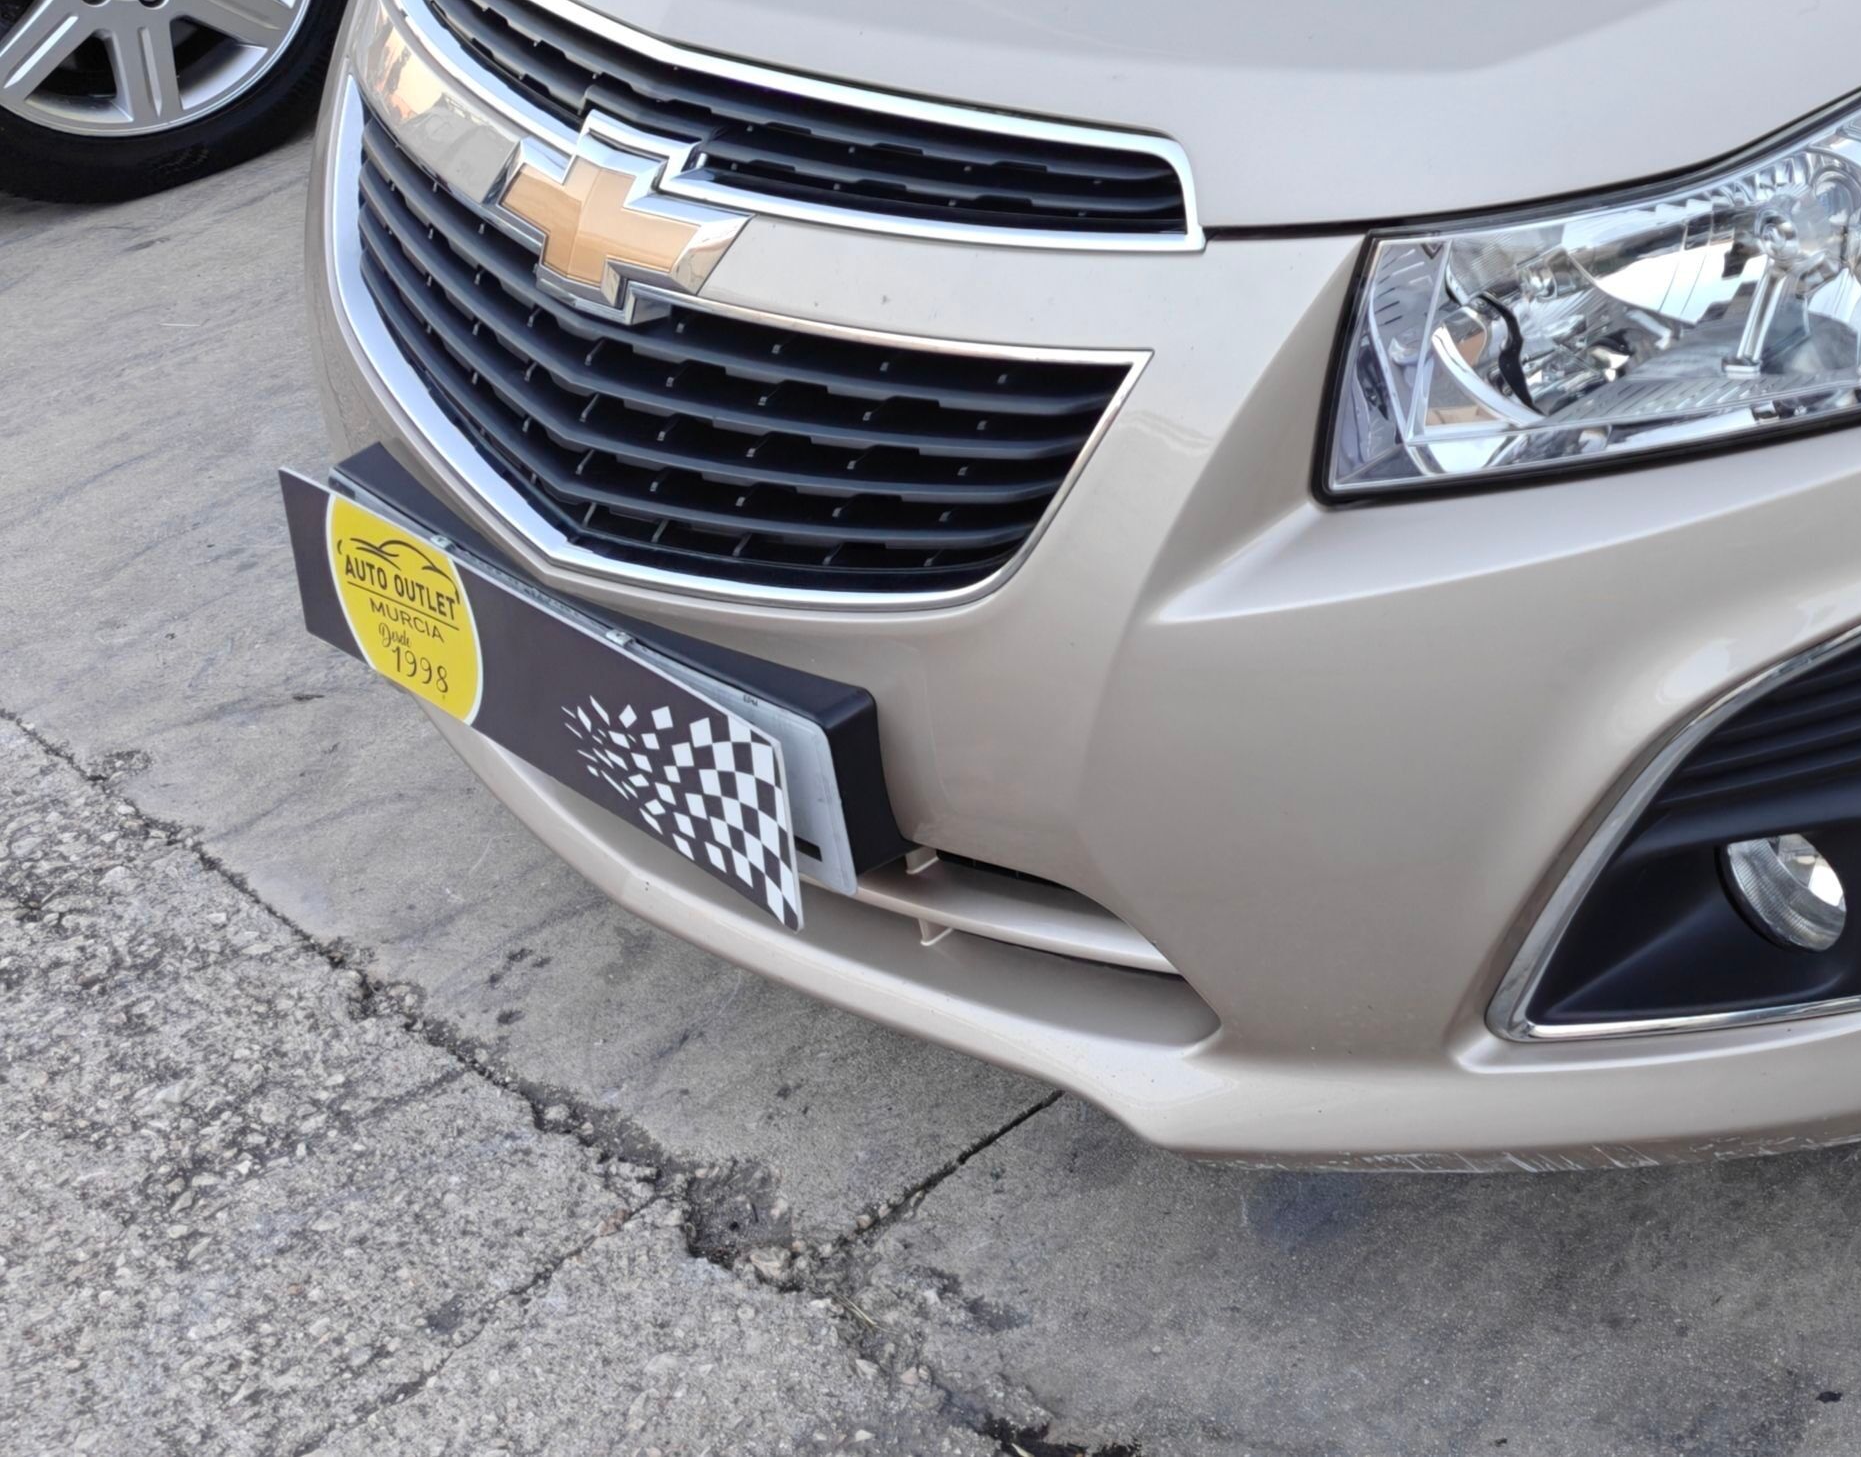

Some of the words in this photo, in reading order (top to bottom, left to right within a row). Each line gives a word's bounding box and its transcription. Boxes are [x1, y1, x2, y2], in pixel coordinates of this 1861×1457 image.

[345, 555, 388, 590] AUTO
[394, 574, 455, 620] OUTLET
[370, 598, 444, 643] MURCIA
[379, 622, 411, 648] Desde
[392, 646, 449, 693] 1998
